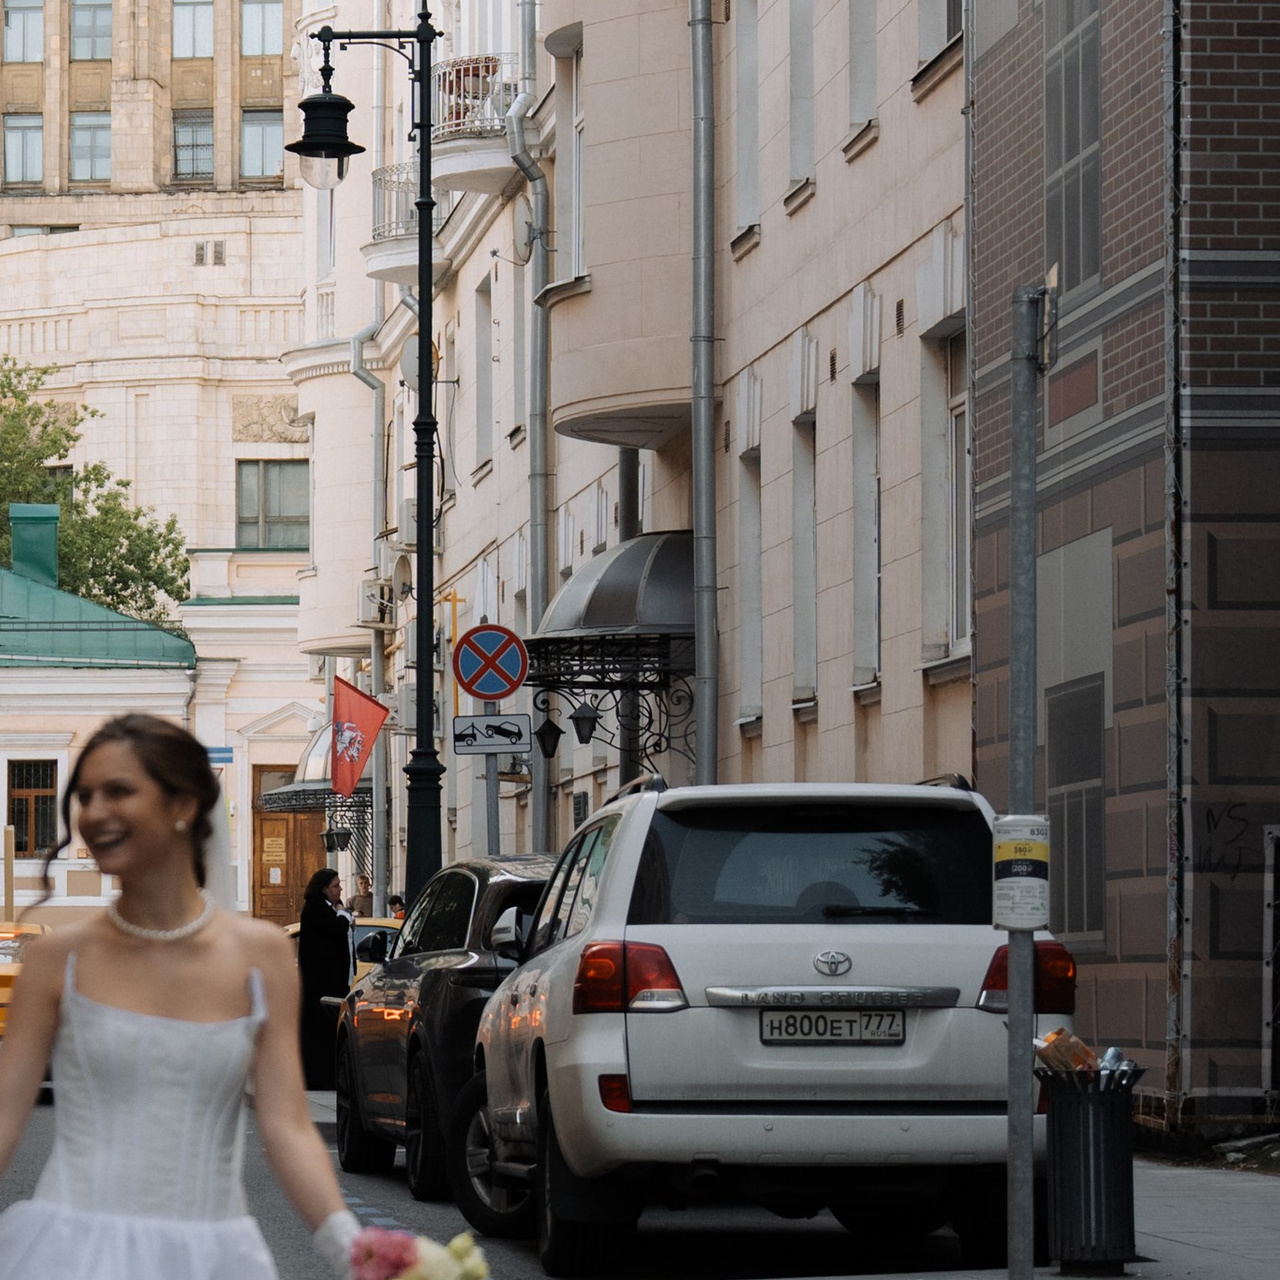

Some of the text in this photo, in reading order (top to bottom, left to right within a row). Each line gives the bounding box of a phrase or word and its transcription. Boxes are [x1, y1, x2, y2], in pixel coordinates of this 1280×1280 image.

[1029, 828, 1048, 836] 8302
[741, 992, 924, 1005] LAND CRUISER
[769, 1013, 897, 1037] Н800ЕТ 777
